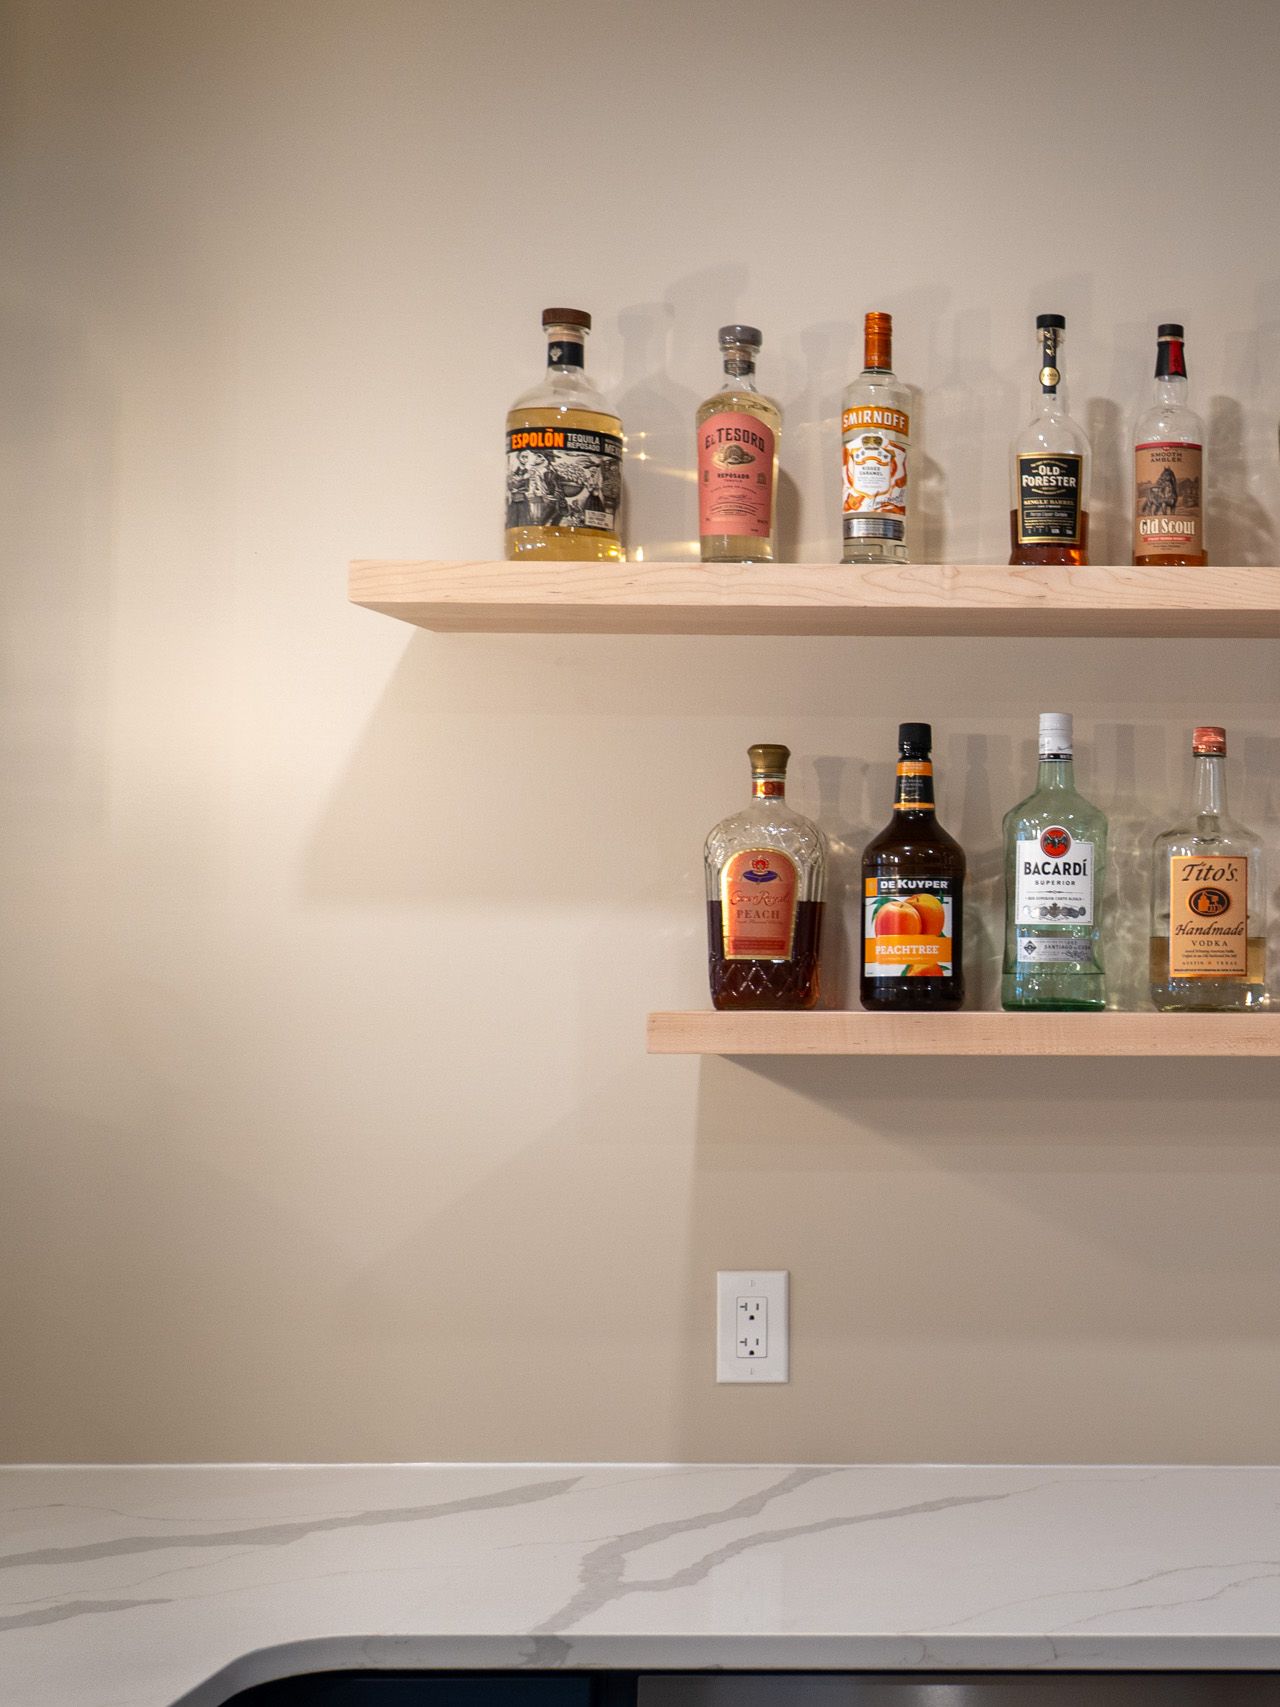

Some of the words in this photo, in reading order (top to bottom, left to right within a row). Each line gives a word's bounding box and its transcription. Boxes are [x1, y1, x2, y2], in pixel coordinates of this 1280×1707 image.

[843, 410, 905, 429] SMIRNOFF
[567, 433, 600, 444] TEQUILA
[716, 428, 765, 453] TESORO
[1038, 465, 1060, 475] OLD
[1022, 475, 1076, 487] FORESTER
[1161, 518, 1195, 535] Scout
[1024, 858, 1088, 876] BACARDÍ
[1182, 861, 1238, 881] Tito's
[736, 909, 780, 919] PEACH
[1175, 920, 1244, 936] Handmade
[875, 945, 940, 954] PEACHTREE
